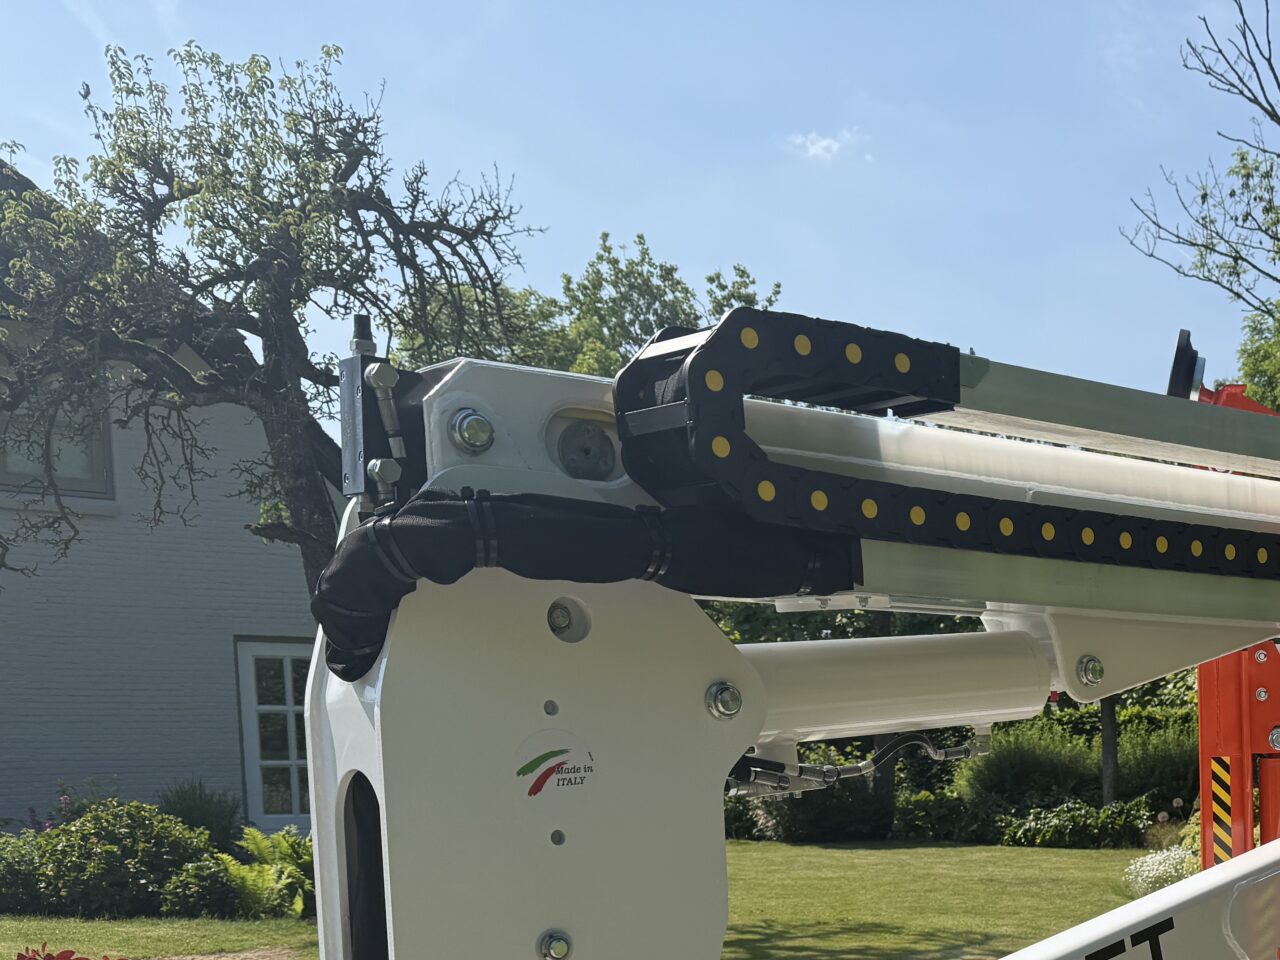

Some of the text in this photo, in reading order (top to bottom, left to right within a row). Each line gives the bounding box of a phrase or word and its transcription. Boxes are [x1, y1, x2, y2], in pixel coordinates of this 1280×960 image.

[555, 764, 593, 775] Made in
[556, 776, 586, 787] ITALY
